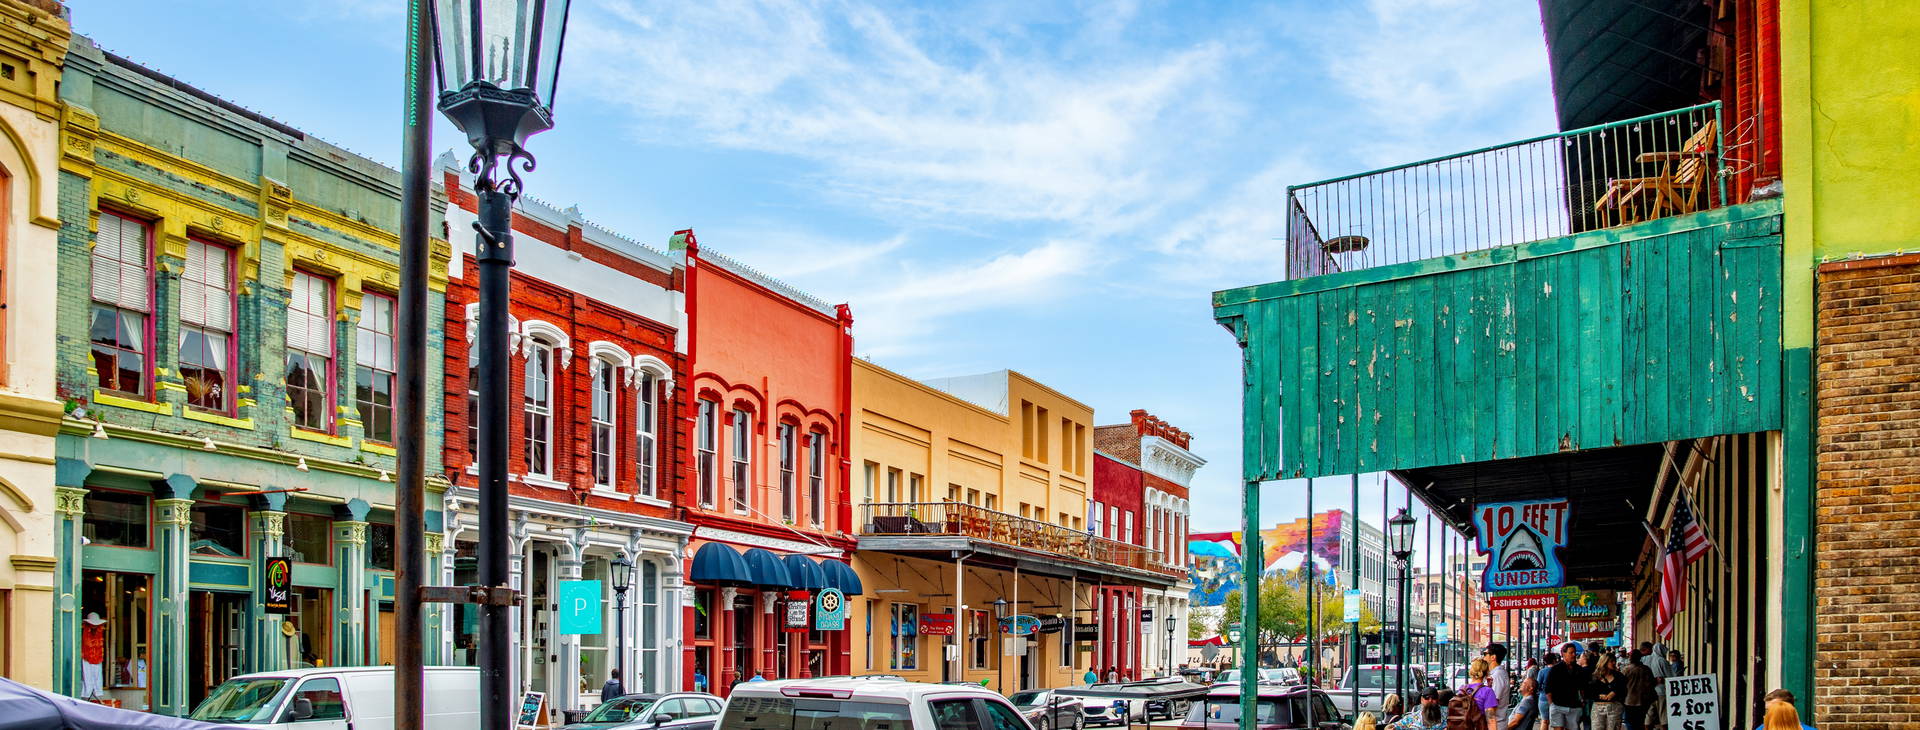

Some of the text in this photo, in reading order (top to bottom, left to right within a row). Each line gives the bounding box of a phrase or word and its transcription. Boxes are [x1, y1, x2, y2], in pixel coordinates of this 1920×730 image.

[1483, 502, 1568, 548] 10 FEET
[1495, 570, 1549, 586] UNDER
[575, 598, 587, 616] P
[1494, 596, 1555, 607] T-Shirts 3 for $10
[1669, 677, 1714, 696] BEER
[1670, 698, 1714, 716] 2 for
[1683, 719, 1706, 730] $5
